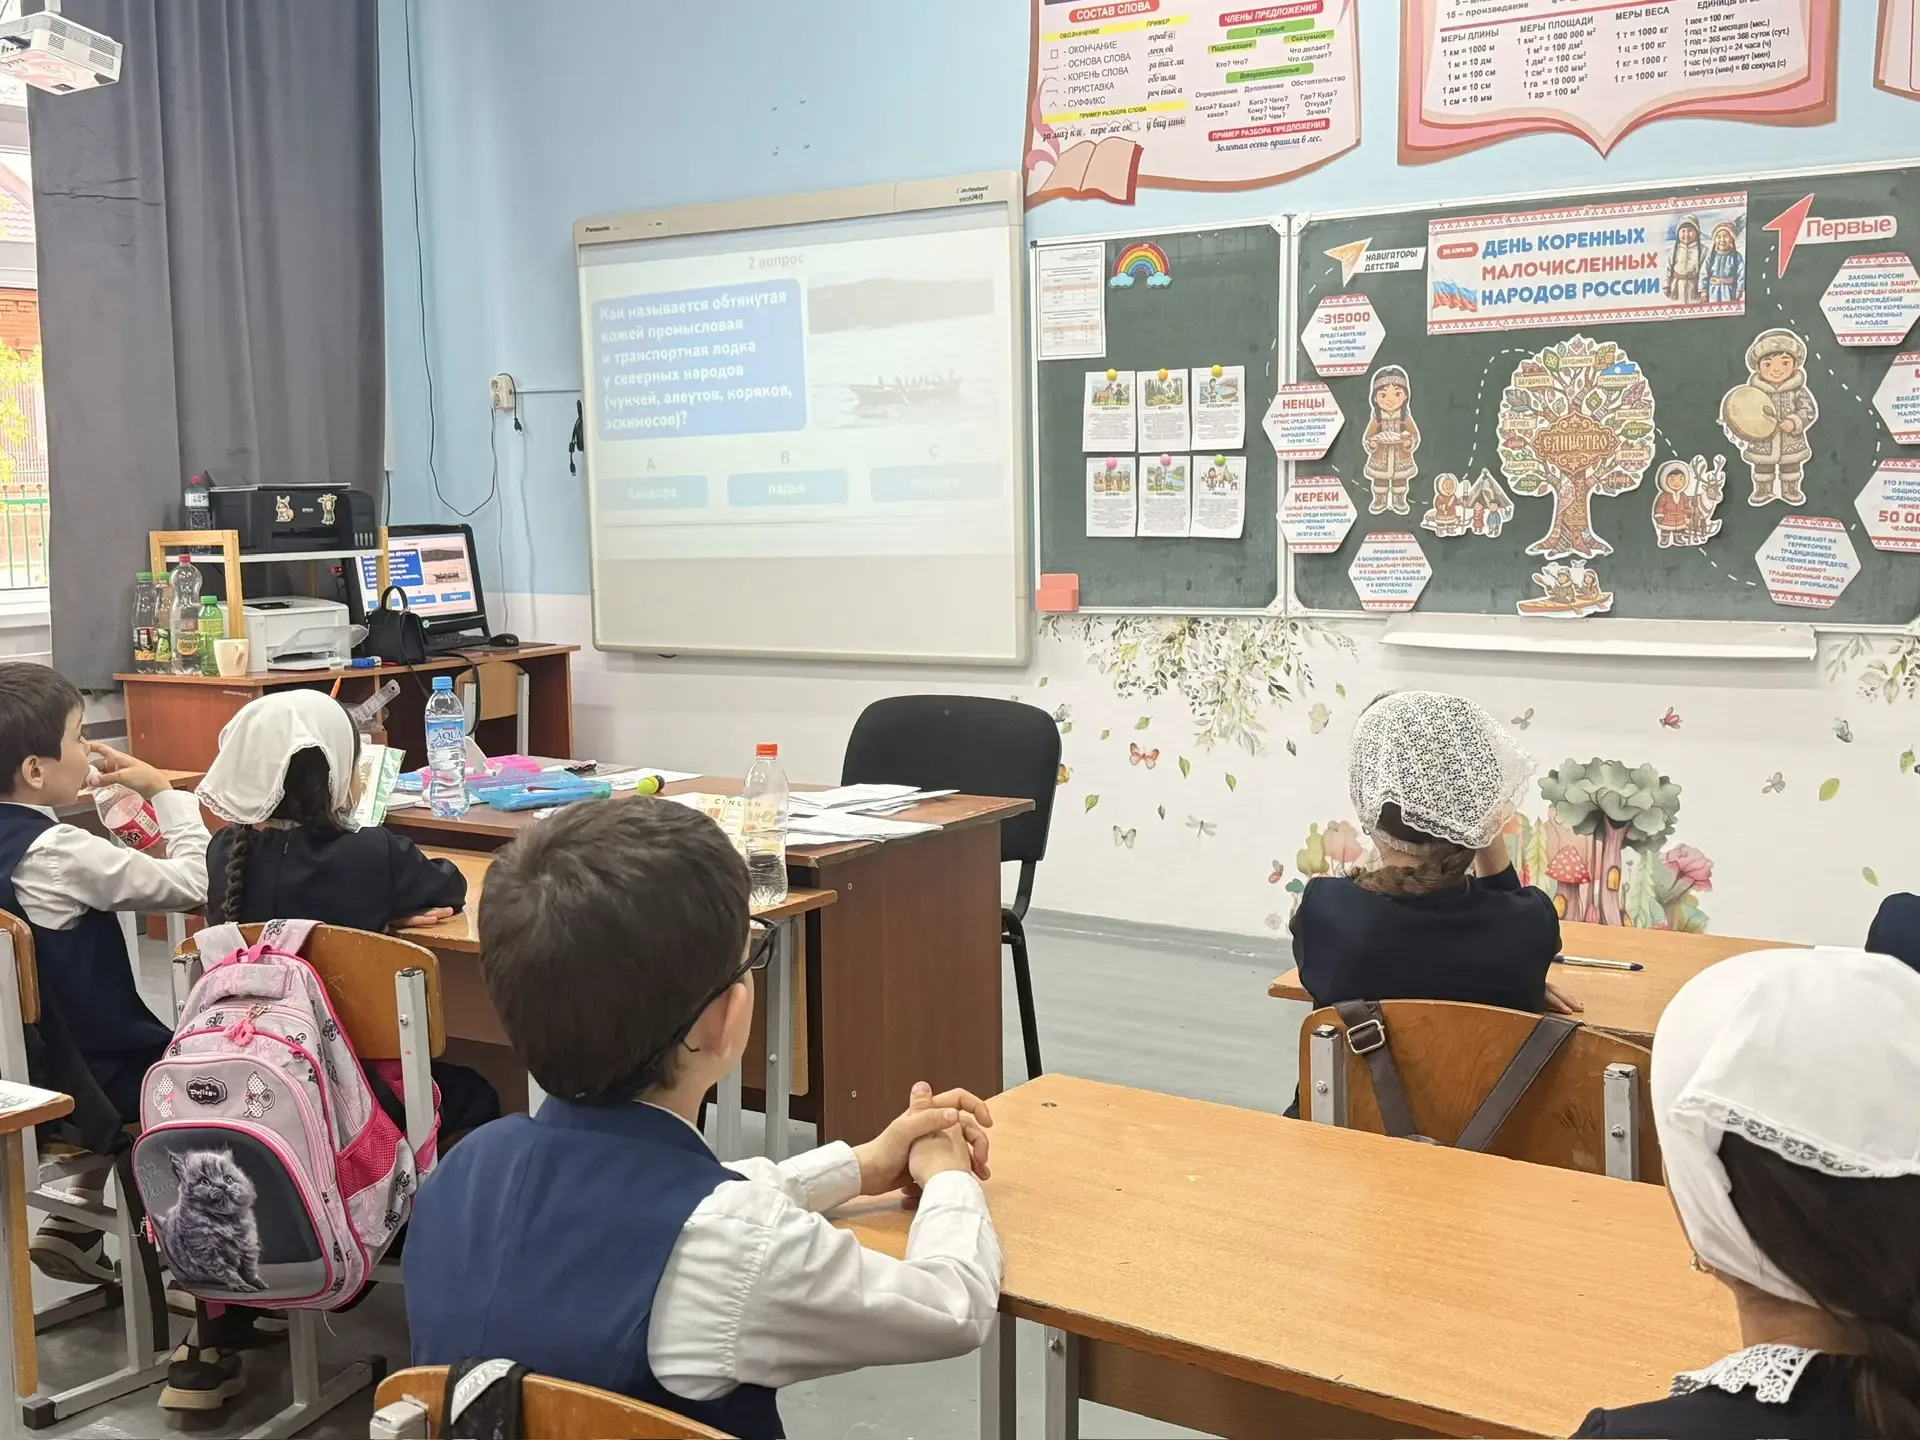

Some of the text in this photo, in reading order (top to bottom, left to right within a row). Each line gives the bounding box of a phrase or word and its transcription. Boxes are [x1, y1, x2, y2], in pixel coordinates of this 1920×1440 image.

[1077, 1, 1151, 21] СОСТАВ СЛОВА
[1224, 2, 1318, 23] ЧЛЕНЫ ПРЕДЛОЖЕНИЯ
[1446, 11, 1456, 19] 15
[1465, 2, 1529, 17] произведение
[1615, 8, 1670, 21] МЕРЫ ВЕСА
[1146, 18, 1170, 27] ПРИМЕР
[1519, 16, 1594, 33] МЕРЫ ПЛОЩАДИ
[1709, 14, 1722, 22] 100
[1059, 28, 1100, 39] ОБОЗНАЧЕНИЕ
[1255, 25, 1285, 35] Главные
[1441, 28, 1499, 43] МЕРЫ ДЛИНЫ
[1638, 27, 1657, 36] 1000
[1709, 25, 1718, 33] 12
[1291, 33, 1327, 43] Сказуемое
[1068, 41, 1117, 55] ОКОНЧАНИЕ
[1211, 42, 1253, 53] Подлежащее
[1302, 43, 1331, 53] делает?
[1468, 45, 1487, 54] 1000
[1068, 52, 1131, 68] ОСНОВА СЛОВА
[1300, 51, 1332, 61] сделает?
[1469, 57, 1492, 66] 10 дм
[1216, 58, 1249, 68] Кто? Что?
[1067, 66, 1129, 81] КОРЕНЬ СЛОВА
[1470, 70, 1483, 79] 100
[1068, 82, 1115, 95] ПРИСТАВКА
[1195, 75, 1346, 98] Определение Дополнение Обстоятельство
[1068, 95, 1106, 108] СУФФИКС
[1300, 90, 1338, 101] Где? Куда?
[1195, 103, 1217, 112] Какой?
[1247, 105, 1267, 114] Кому?
[1304, 99, 1333, 108] Откуда?
[1079, 106, 1147, 119] ПРИМЕР РАЗБОРА СЛОВА
[1212, 120, 1326, 139] ПРИМЕР РАЗБОРА ПРЕДЛОЖЕНИЯ
[1215, 143, 1248, 152] Золотая
[1249, 141, 1269, 149] осень
[1270, 138, 1300, 148] пришла
[1806, 218, 1892, 241] Первые
[1451, 246, 1473, 254] АПРЕЛЯ
[1481, 227, 1646, 260] ДЕНЬ КОРЕННЫХ
[747, 253, 804, 270] 2 вопрос
[1365, 249, 1418, 261] НАВИГАТОРЫ
[1365, 261, 1400, 271] ДЕТСТВА
[1481, 252, 1658, 281] МАЛОЧИСЛЕННЫХ
[1848, 273, 1877, 281] ЗАКОНЫ
[1833, 281, 1879, 289] НАПРАВЛЕНЫ
[1890, 279, 1918, 287] ЗАЩИТУ
[1481, 278, 1660, 306] НАРОДОВ РОССИИ
[600, 291, 787, 321] Как называется обтянутая
[601, 318, 743, 344] кожей промысловая
[613, 346, 709, 367] транспортная
[712, 340, 756, 357] лодка
[603, 364, 744, 390] у северных народов
[605, 383, 793, 411] (чукчей, алеутов, коряков,
[1282, 398, 1325, 410] НЕНЦЫ
[605, 410, 688, 430] эскимосов)?
[1294, 491, 1339, 503] КЕРЕКИ
[1878, 510, 1900, 523] 50
[435, 731, 463, 741] AQUA
